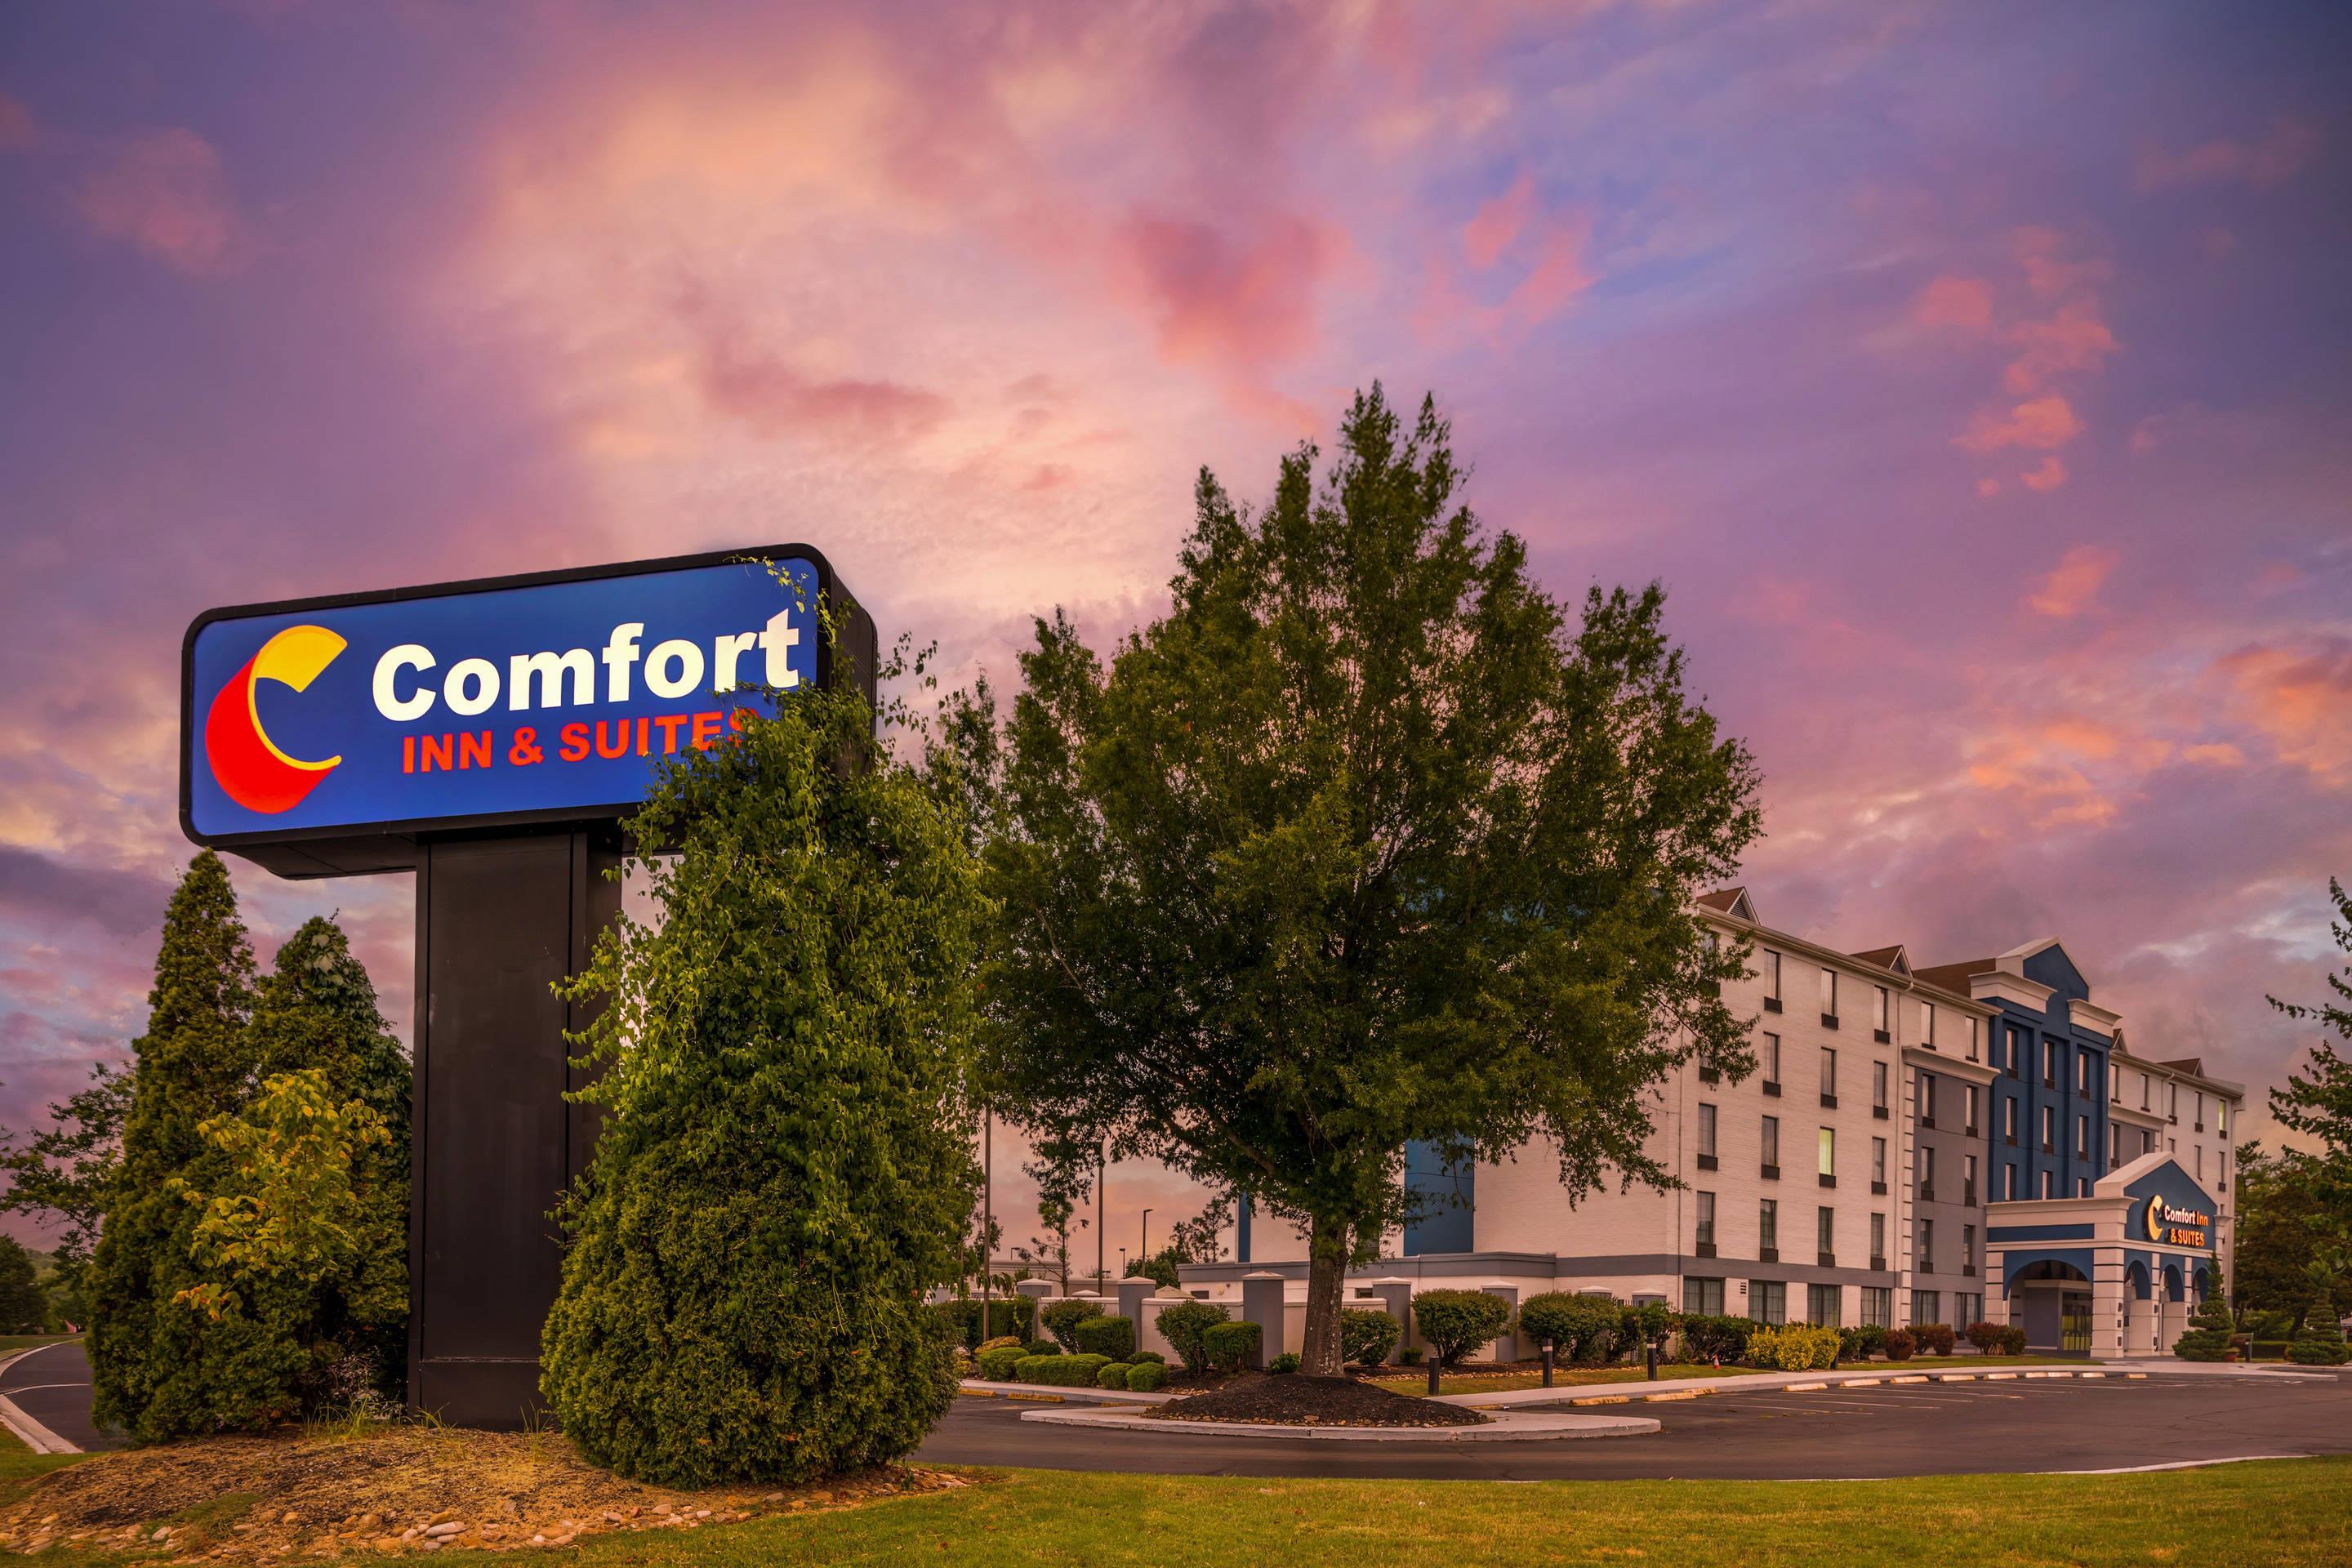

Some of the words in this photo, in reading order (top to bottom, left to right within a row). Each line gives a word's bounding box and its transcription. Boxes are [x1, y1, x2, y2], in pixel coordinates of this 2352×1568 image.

[372, 608, 800, 722] Comfort
[403, 731, 492, 774] INN
[509, 726, 545, 767] &
[2164, 1205, 2196, 1225] Comfort
[2197, 1210, 2208, 1227] Inn
[2171, 1228, 2177, 1243] &
[2178, 1229, 2204, 1246] SUITES
